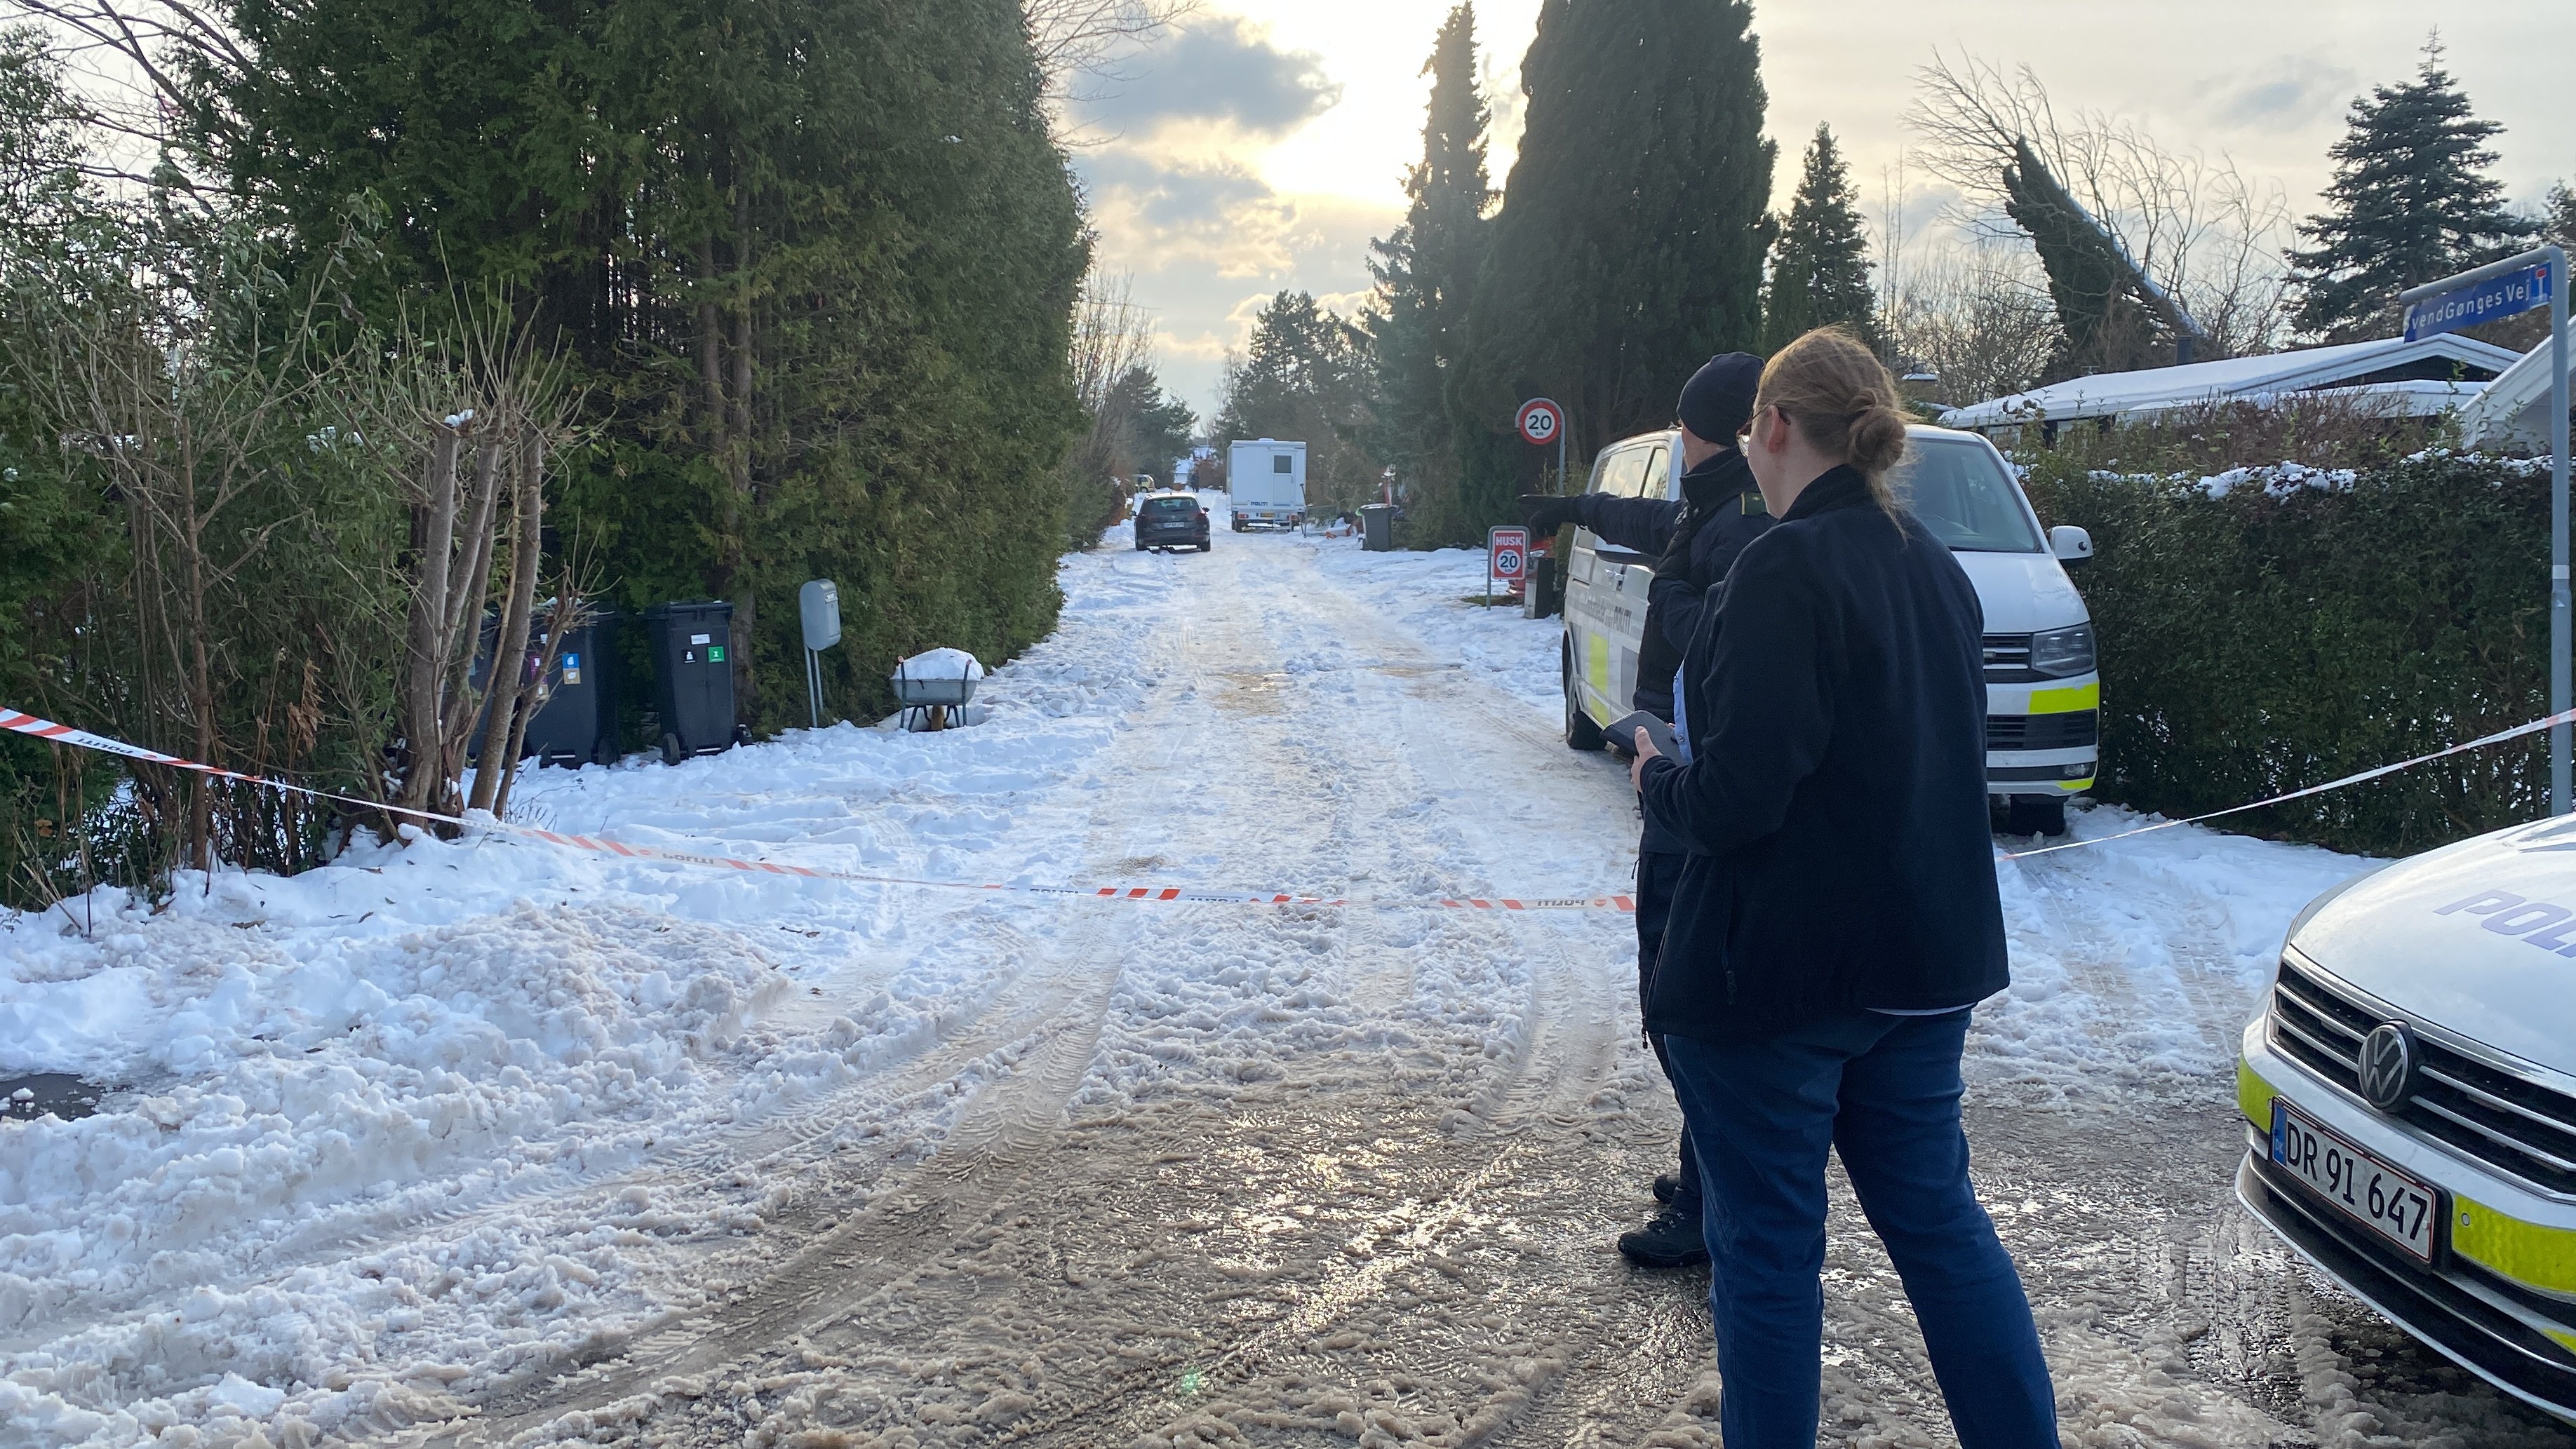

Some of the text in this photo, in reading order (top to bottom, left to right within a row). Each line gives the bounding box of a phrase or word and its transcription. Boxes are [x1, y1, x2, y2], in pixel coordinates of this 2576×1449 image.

[2505, 279, 2530, 302] Vej
[1529, 415, 1552, 430] 20
[1496, 536, 1522, 546] HUSK
[1500, 555, 1518, 567] 20
[76, 738, 133, 754] POLITI
[2433, 889, 2576, 958] POL
[2274, 1140, 2283, 1154] DK
[2288, 1121, 2427, 1241] DR 91 647
